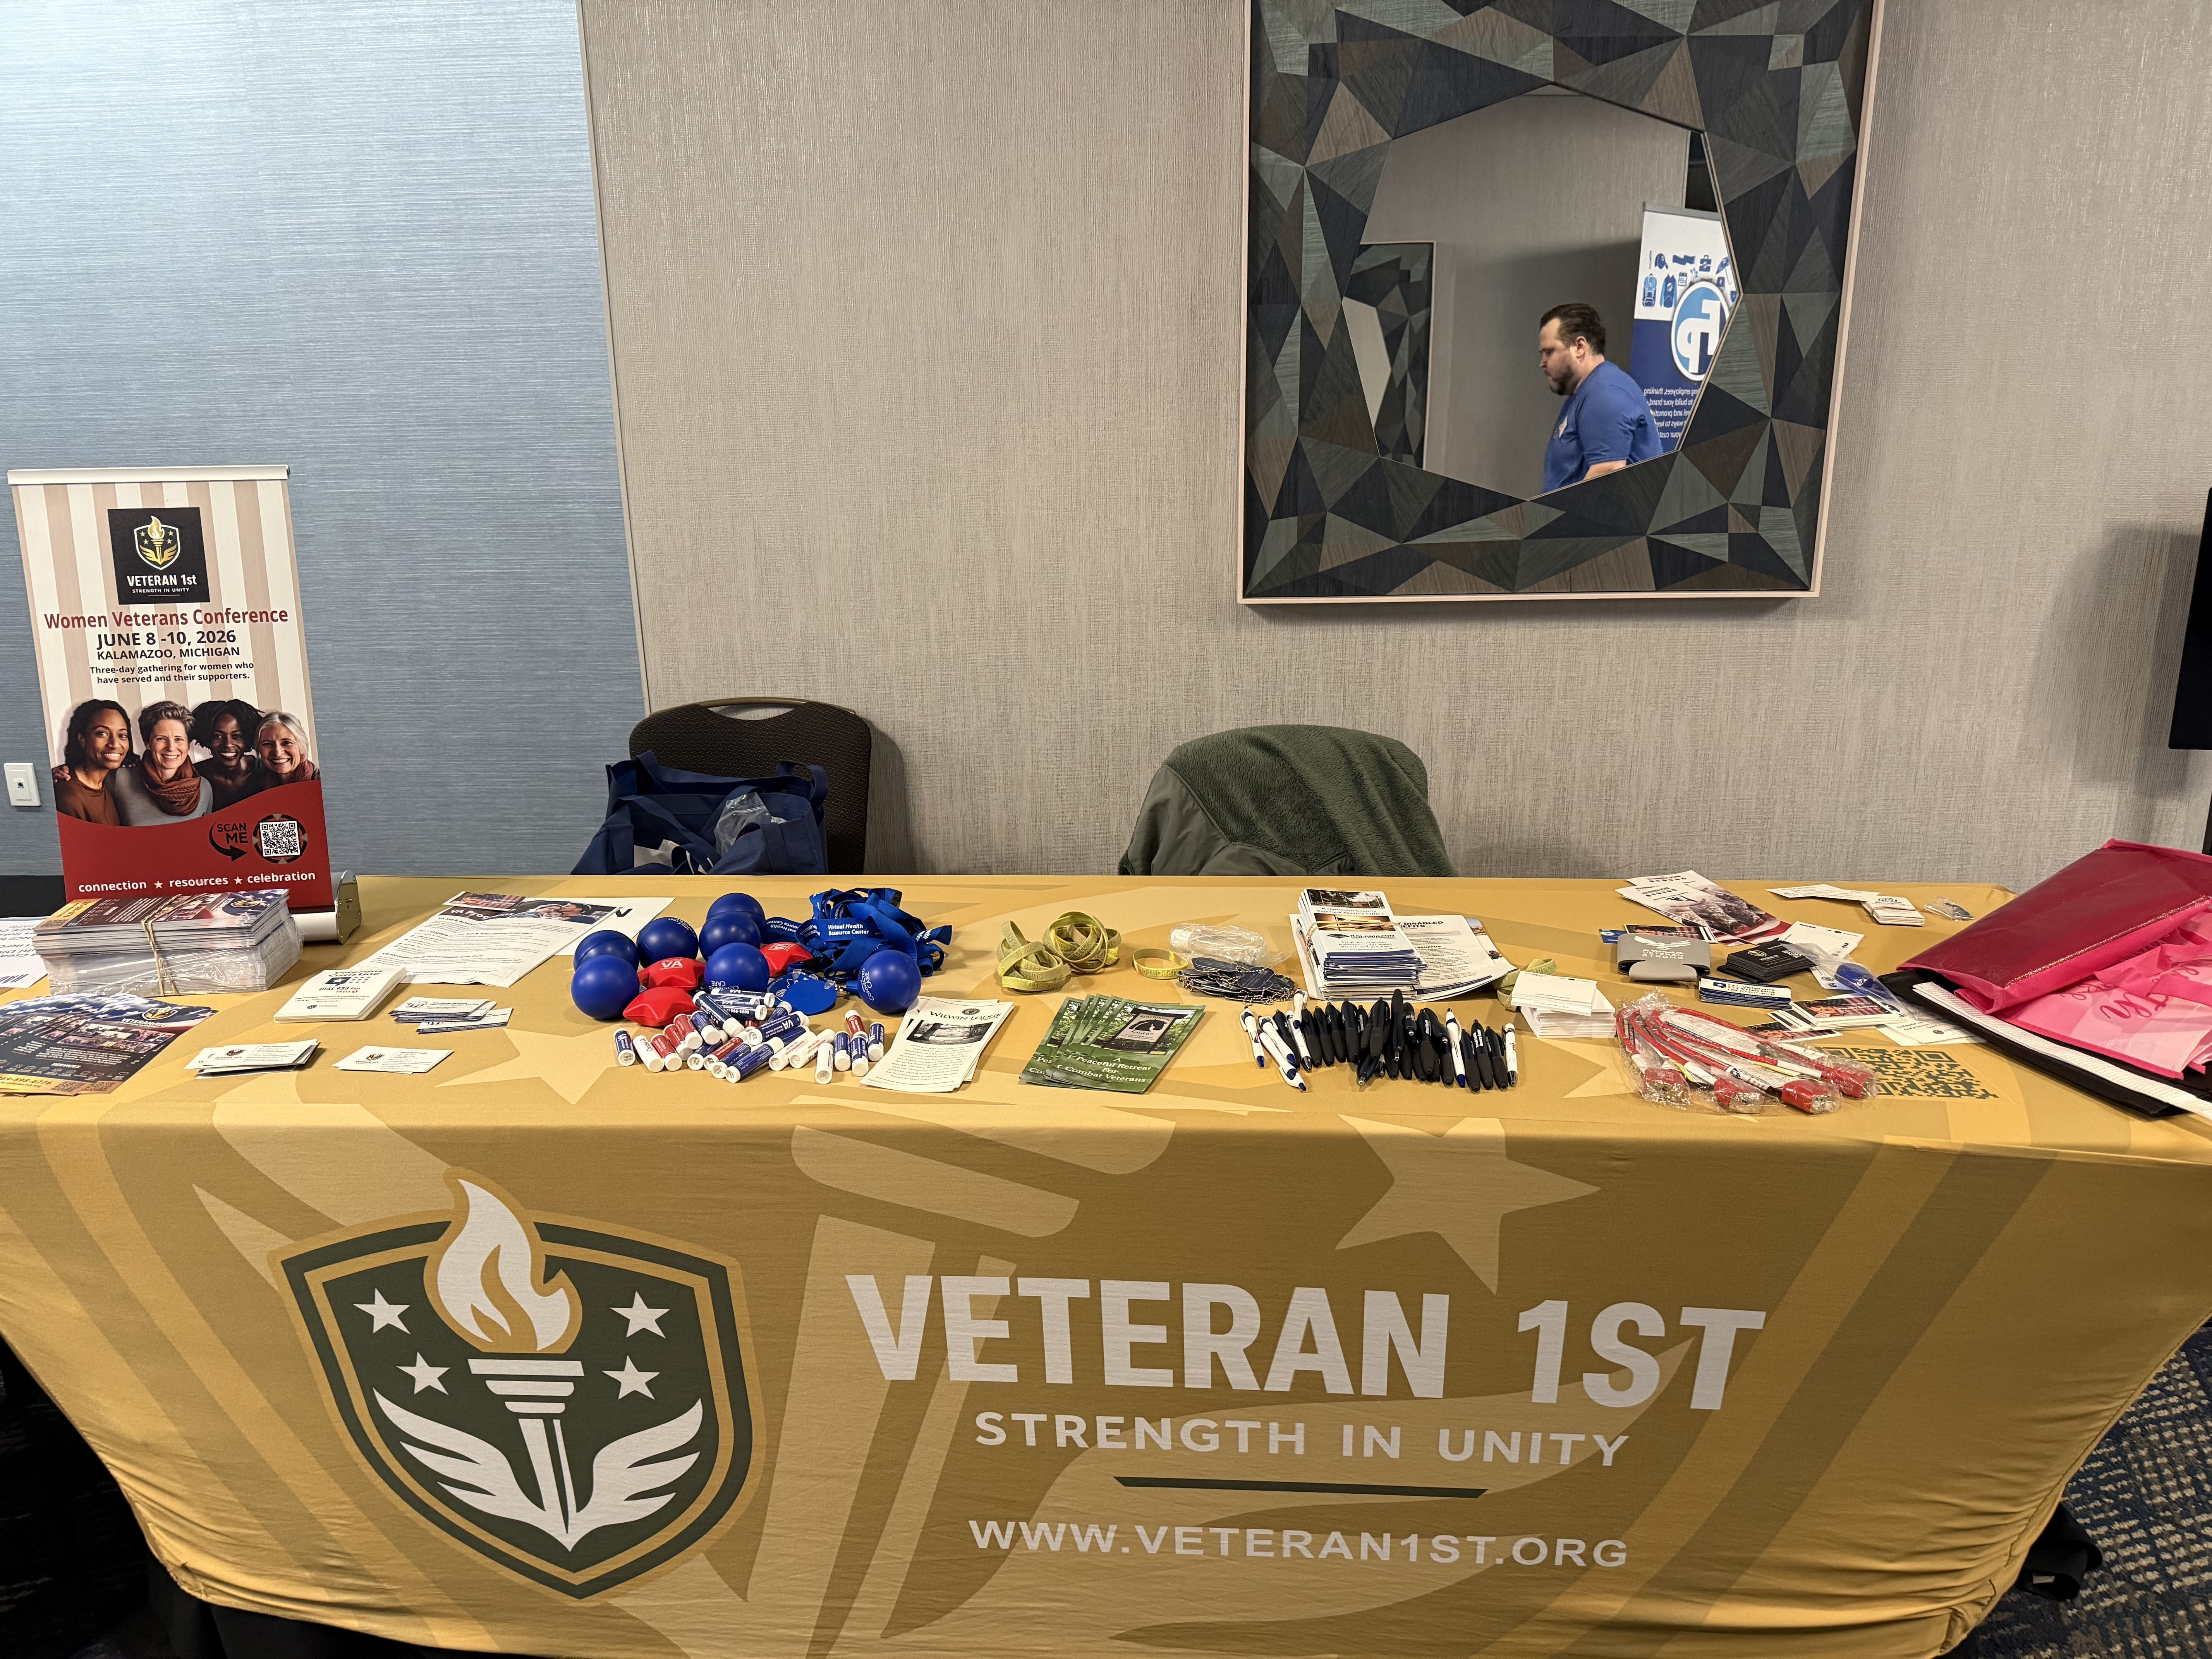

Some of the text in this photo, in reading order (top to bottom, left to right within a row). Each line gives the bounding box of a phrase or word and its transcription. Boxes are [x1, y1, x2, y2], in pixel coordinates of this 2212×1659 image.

[127, 574, 197, 586] VETERAN 1st
[44, 608, 288, 629] Women Veterans Conference
[97, 630, 236, 650] JUNE 8 -10, 2026
[97, 647, 240, 660] KALAMAZOO, MICHIGAN
[90, 665, 135, 675] Three-day
[137, 664, 182, 674] gathering
[121, 674, 152, 683] served
[173, 673, 196, 681] their
[198, 672, 250, 682] supporters.
[217, 823, 247, 833] SCAN
[226, 832, 248, 844] ME
[78, 871, 316, 893] connection resources celebration
[862, 968, 874, 1001] CONNECTED
[930, 1011, 968, 1020] WILWIN
[782, 1019, 794, 1030] VA
[1076, 1056, 1116, 1067] Peaceful
[1065, 1066, 1147, 1082] Combat Veterans
[845, 1275, 1766, 1410] VETERAN 1ST
[975, 1412, 1629, 1467] STRENGTH IN UNITY
[969, 1520, 1626, 1567] WWW.VETERAN1ST.ORG
